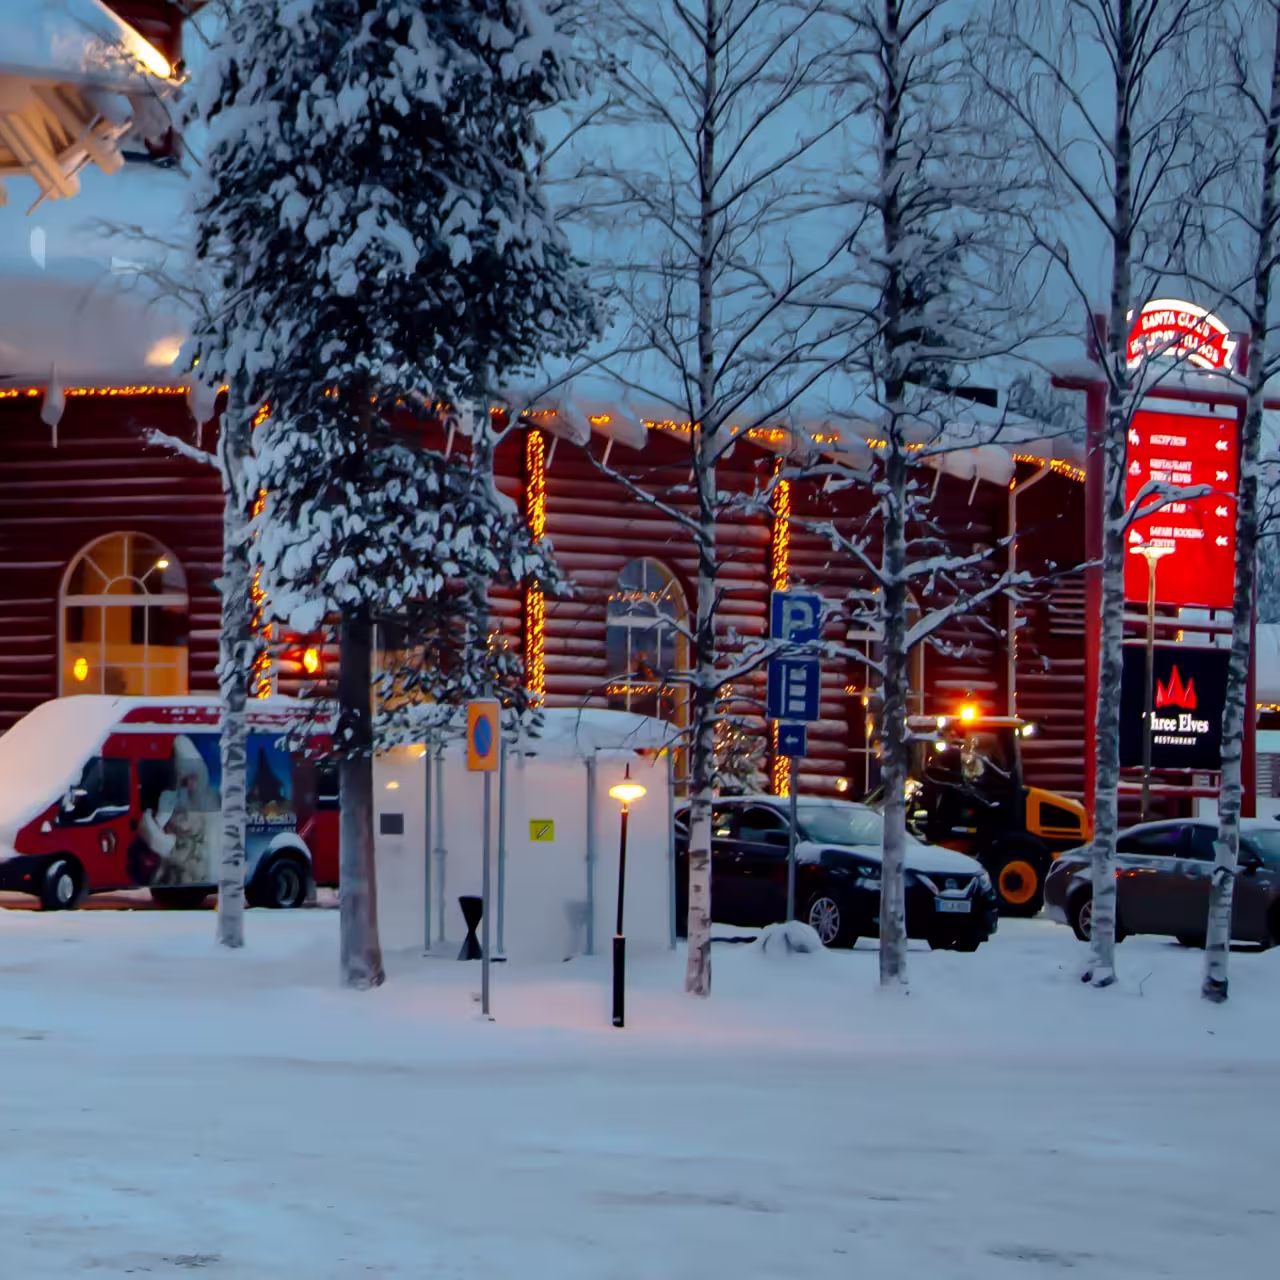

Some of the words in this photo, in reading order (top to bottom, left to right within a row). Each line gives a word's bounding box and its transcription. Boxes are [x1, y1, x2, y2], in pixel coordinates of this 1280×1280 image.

[1141, 311, 1176, 330] SANTA
[1150, 458, 1192, 472] RESTAURANT
[1142, 712, 1177, 732] hree
[1178, 713, 1209, 733] Elves
[1153, 735, 1197, 745] RESTAURANT
